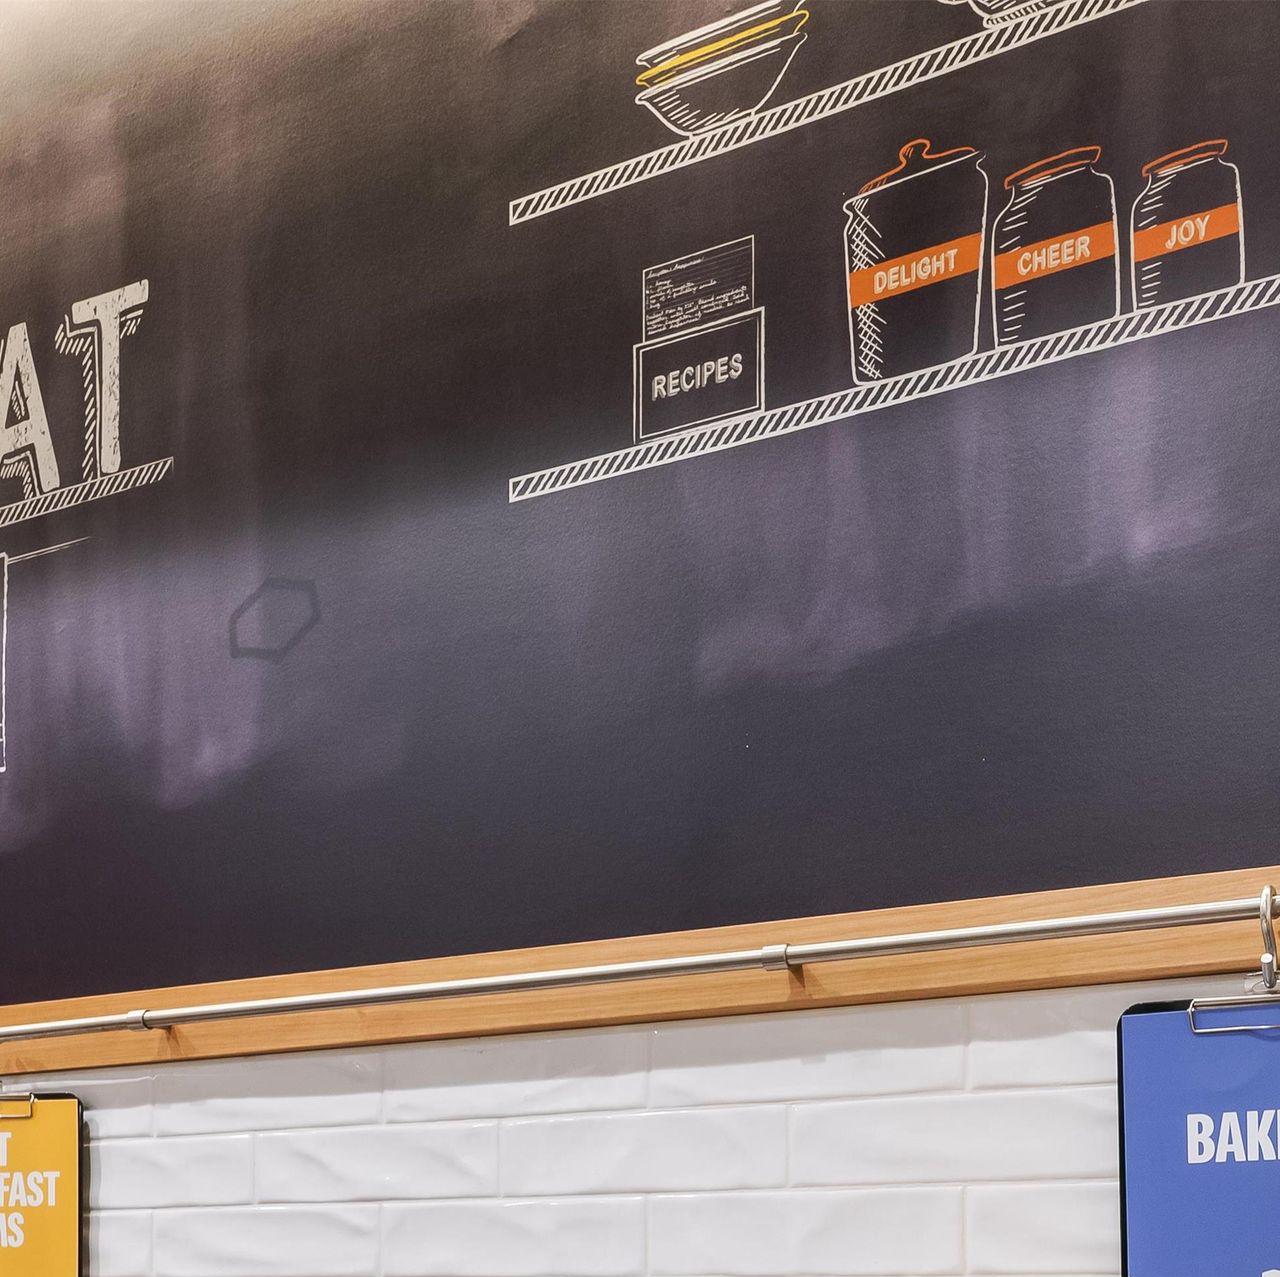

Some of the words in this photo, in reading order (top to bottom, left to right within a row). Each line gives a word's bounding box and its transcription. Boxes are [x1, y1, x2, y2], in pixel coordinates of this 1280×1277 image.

[1165, 214, 1211, 250] JOY
[873, 248, 958, 295] DELIGHT
[1017, 235, 1091, 276] CHEER
[651, 353, 743, 402] RECIPES
